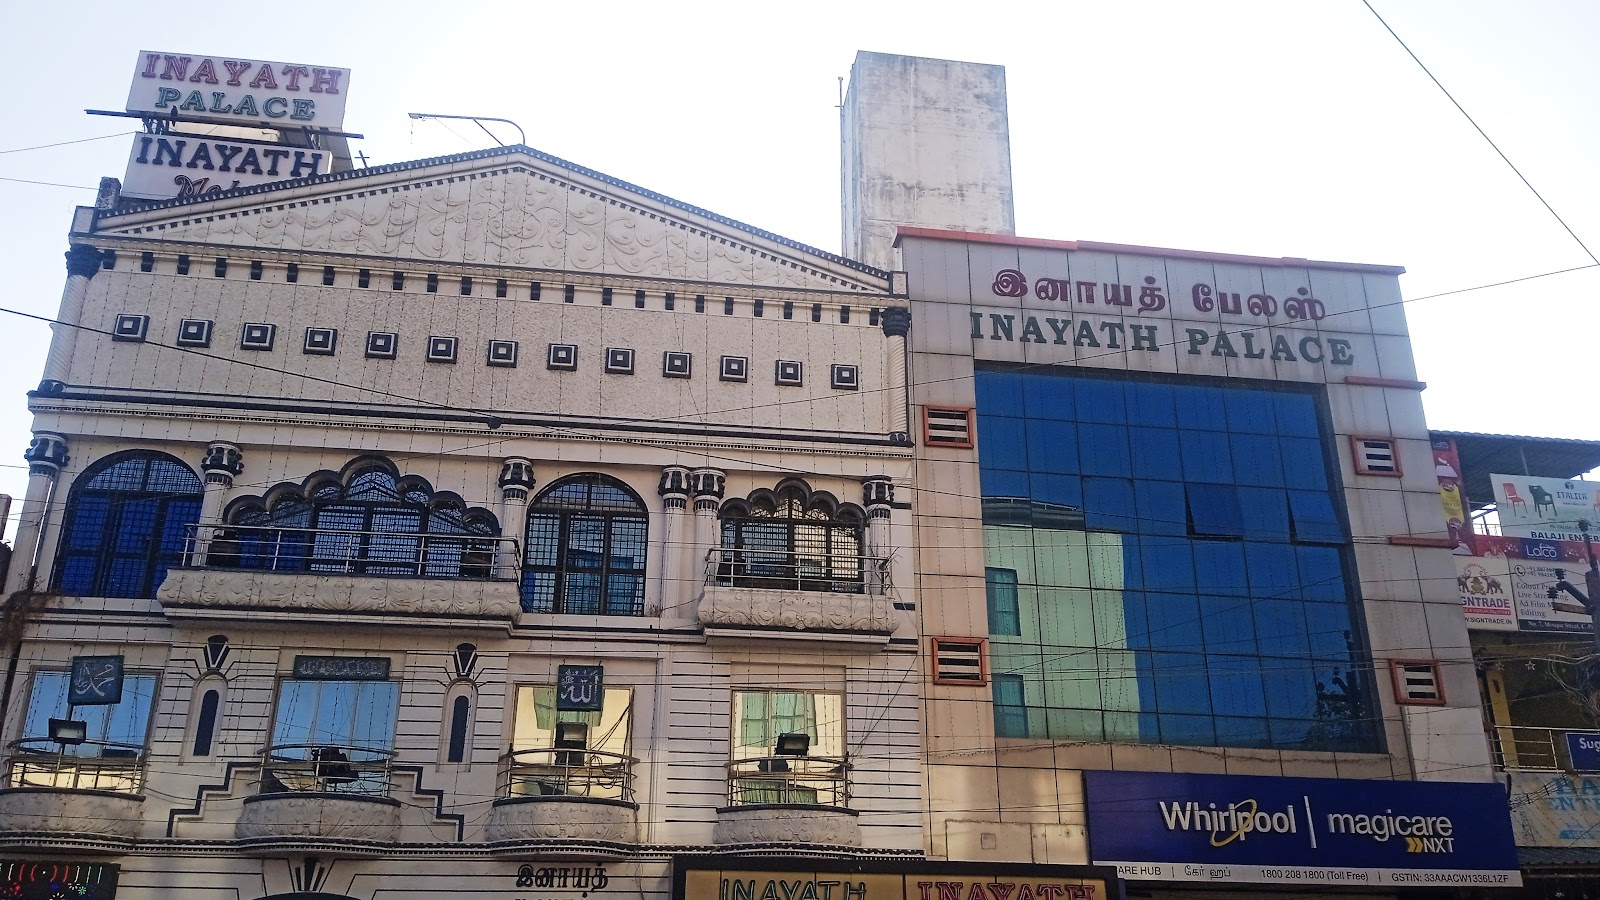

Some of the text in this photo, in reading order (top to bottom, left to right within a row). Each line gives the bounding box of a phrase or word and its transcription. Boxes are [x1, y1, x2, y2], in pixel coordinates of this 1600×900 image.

[141, 54, 341, 94] INAYATH
[155, 87, 316, 121] PALACE
[135, 137, 323, 177] INAYATH
[992, 268, 1326, 321] இனாயத் பேலஸ்
[970, 312, 1355, 366] INAYATH PALACE
[1531, 531, 1565, 540] BALAJI
[1516, 582, 1539, 590] Colour
[1520, 608, 1546, 618] Editing
[1160, 800, 1453, 842] Whirlpool magicare
[1423, 838, 1455, 853] NXT
[516, 863, 608, 893] இனாயத்
[1140, 866, 1162, 876] HUB
[1261, 869, 1369, 883] 1800 208 1800 (Toll Free)
[1391, 872, 1422, 882] GSTIN:
[721, 879, 867, 900] INAYATH
[917, 881, 1096, 900] INAYATH
